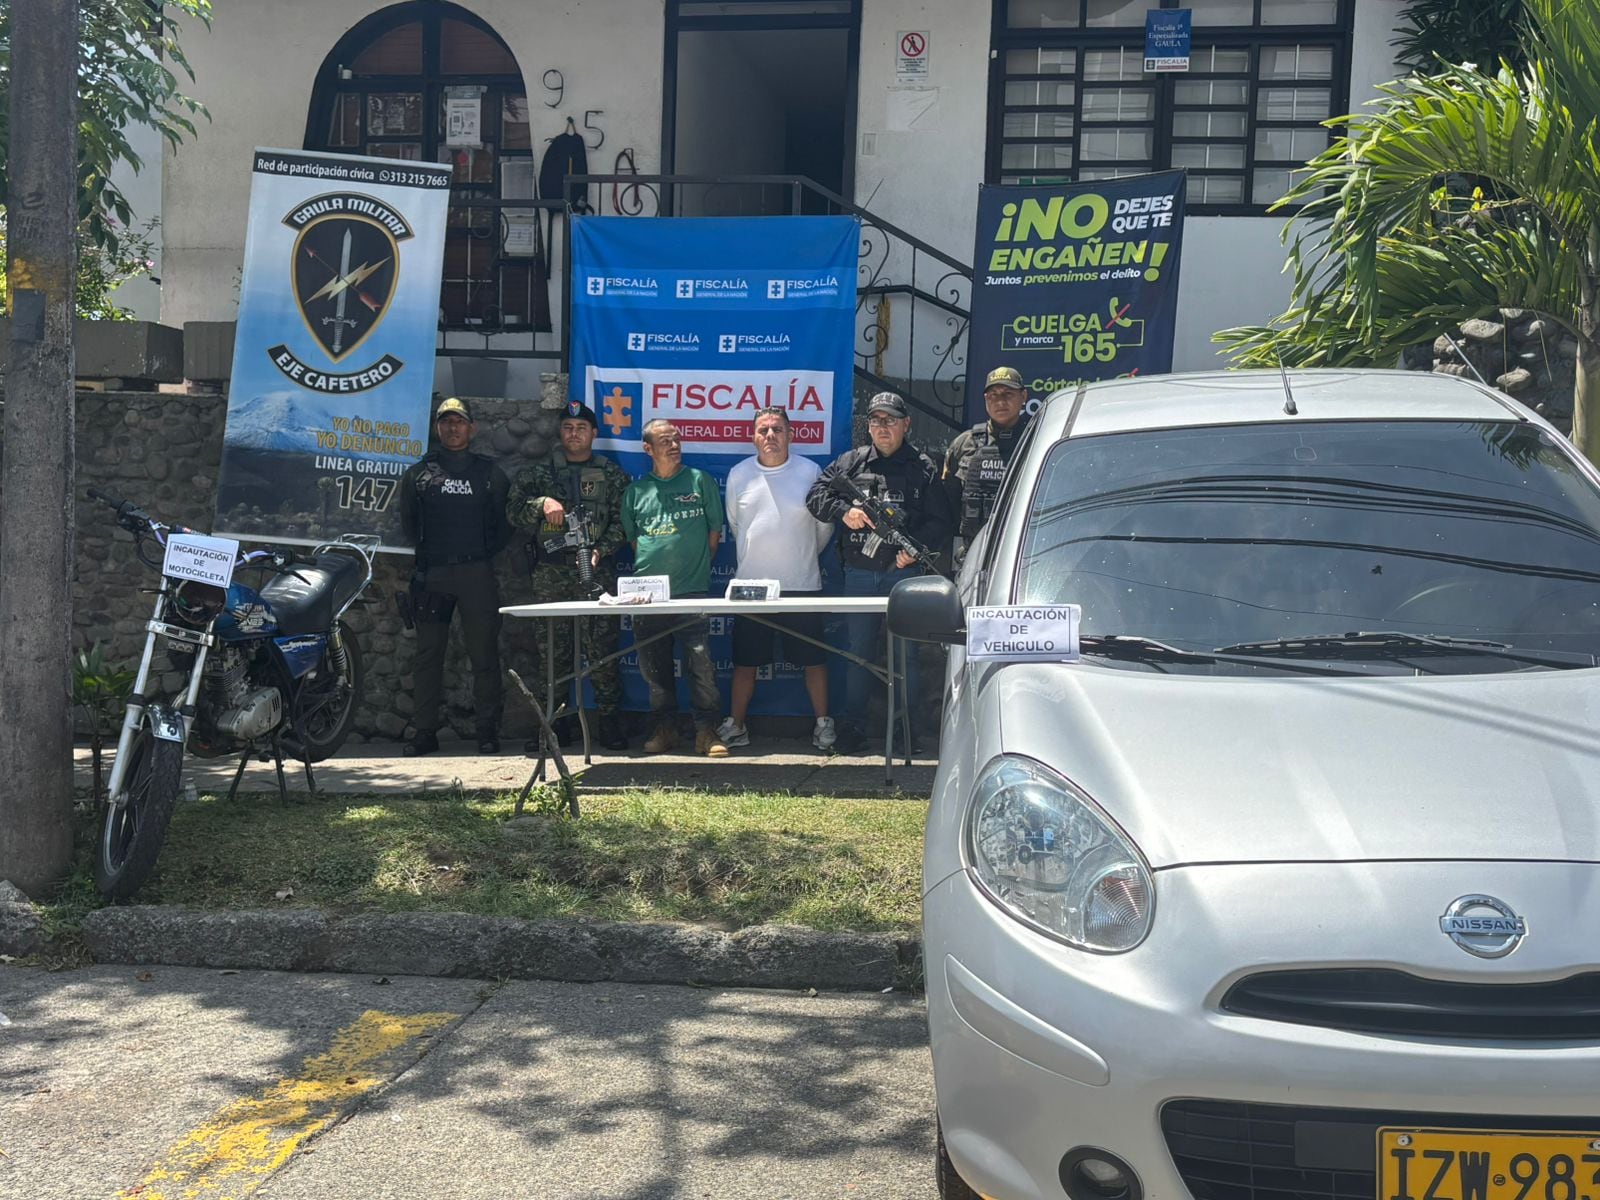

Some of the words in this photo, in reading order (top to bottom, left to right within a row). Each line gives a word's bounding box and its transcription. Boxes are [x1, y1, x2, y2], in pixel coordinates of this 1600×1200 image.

[543, 69, 563, 108] 9
[585, 110, 604, 149] 5
[258, 158, 275, 171] Red
[277, 160, 288, 172] de
[290, 163, 348, 178] participación
[350, 168, 375, 180] cívica
[390, 172, 407, 183] 313
[408, 173, 425, 185] 215
[426, 174, 447, 186] 7665
[1114, 194, 1174, 215] DEJES
[292, 198, 343, 225] GAULA
[348, 198, 406, 236] MILITAR
[994, 193, 1109, 243] ¡NO
[1112, 216, 1148, 234] QUE
[1152, 212, 1173, 228] TE
[606, 278, 658, 289] FISCALÍA
[695, 278, 748, 289] FISCALÍA
[787, 275, 838, 289] FISCALÍA
[984, 274, 1022, 286] Juntos
[1024, 270, 1098, 286] prevenimos
[1100, 269, 1111, 280] el
[1112, 267, 1141, 280] delito
[1012, 312, 1101, 334] CUELGA
[647, 333, 700, 343] FISCALÍA
[738, 333, 790, 344] FISCALÍA
[1014, 338, 1022, 347] y
[1022, 336, 1054, 345] marca
[1061, 332, 1116, 364] 165
[276, 352, 305, 380] EJE
[304, 362, 394, 391] CAFETERO
[652, 378, 824, 412] FISCALÍA
[332, 416, 349, 432] YO
[353, 418, 372, 434] NO
[375, 421, 410, 438] PAGO
[675, 425, 720, 438] NERAL
[724, 426, 742, 438] DE
[746, 426, 754, 438] L
[316, 432, 337, 448] YO
[340, 434, 422, 457] DENUNCIO
[315, 456, 352, 472] LINEA
[356, 458, 412, 476] GRATUIT
[982, 460, 1004, 470] GAUL
[444, 479, 471, 487] GAULA
[335, 476, 397, 512] 147
[174, 544, 228, 562] INCAUTACIÓN
[194, 558, 206, 566] DE
[168, 564, 225, 582] MOTOCICLETA
[972, 608, 1066, 620] INCAUTACIÓN
[1010, 624, 1028, 634] DE
[984, 640, 1055, 652] VEHICULO
[1452, 920, 1517, 930] NISSAN
[1391, 1148, 1490, 1200] IZW
